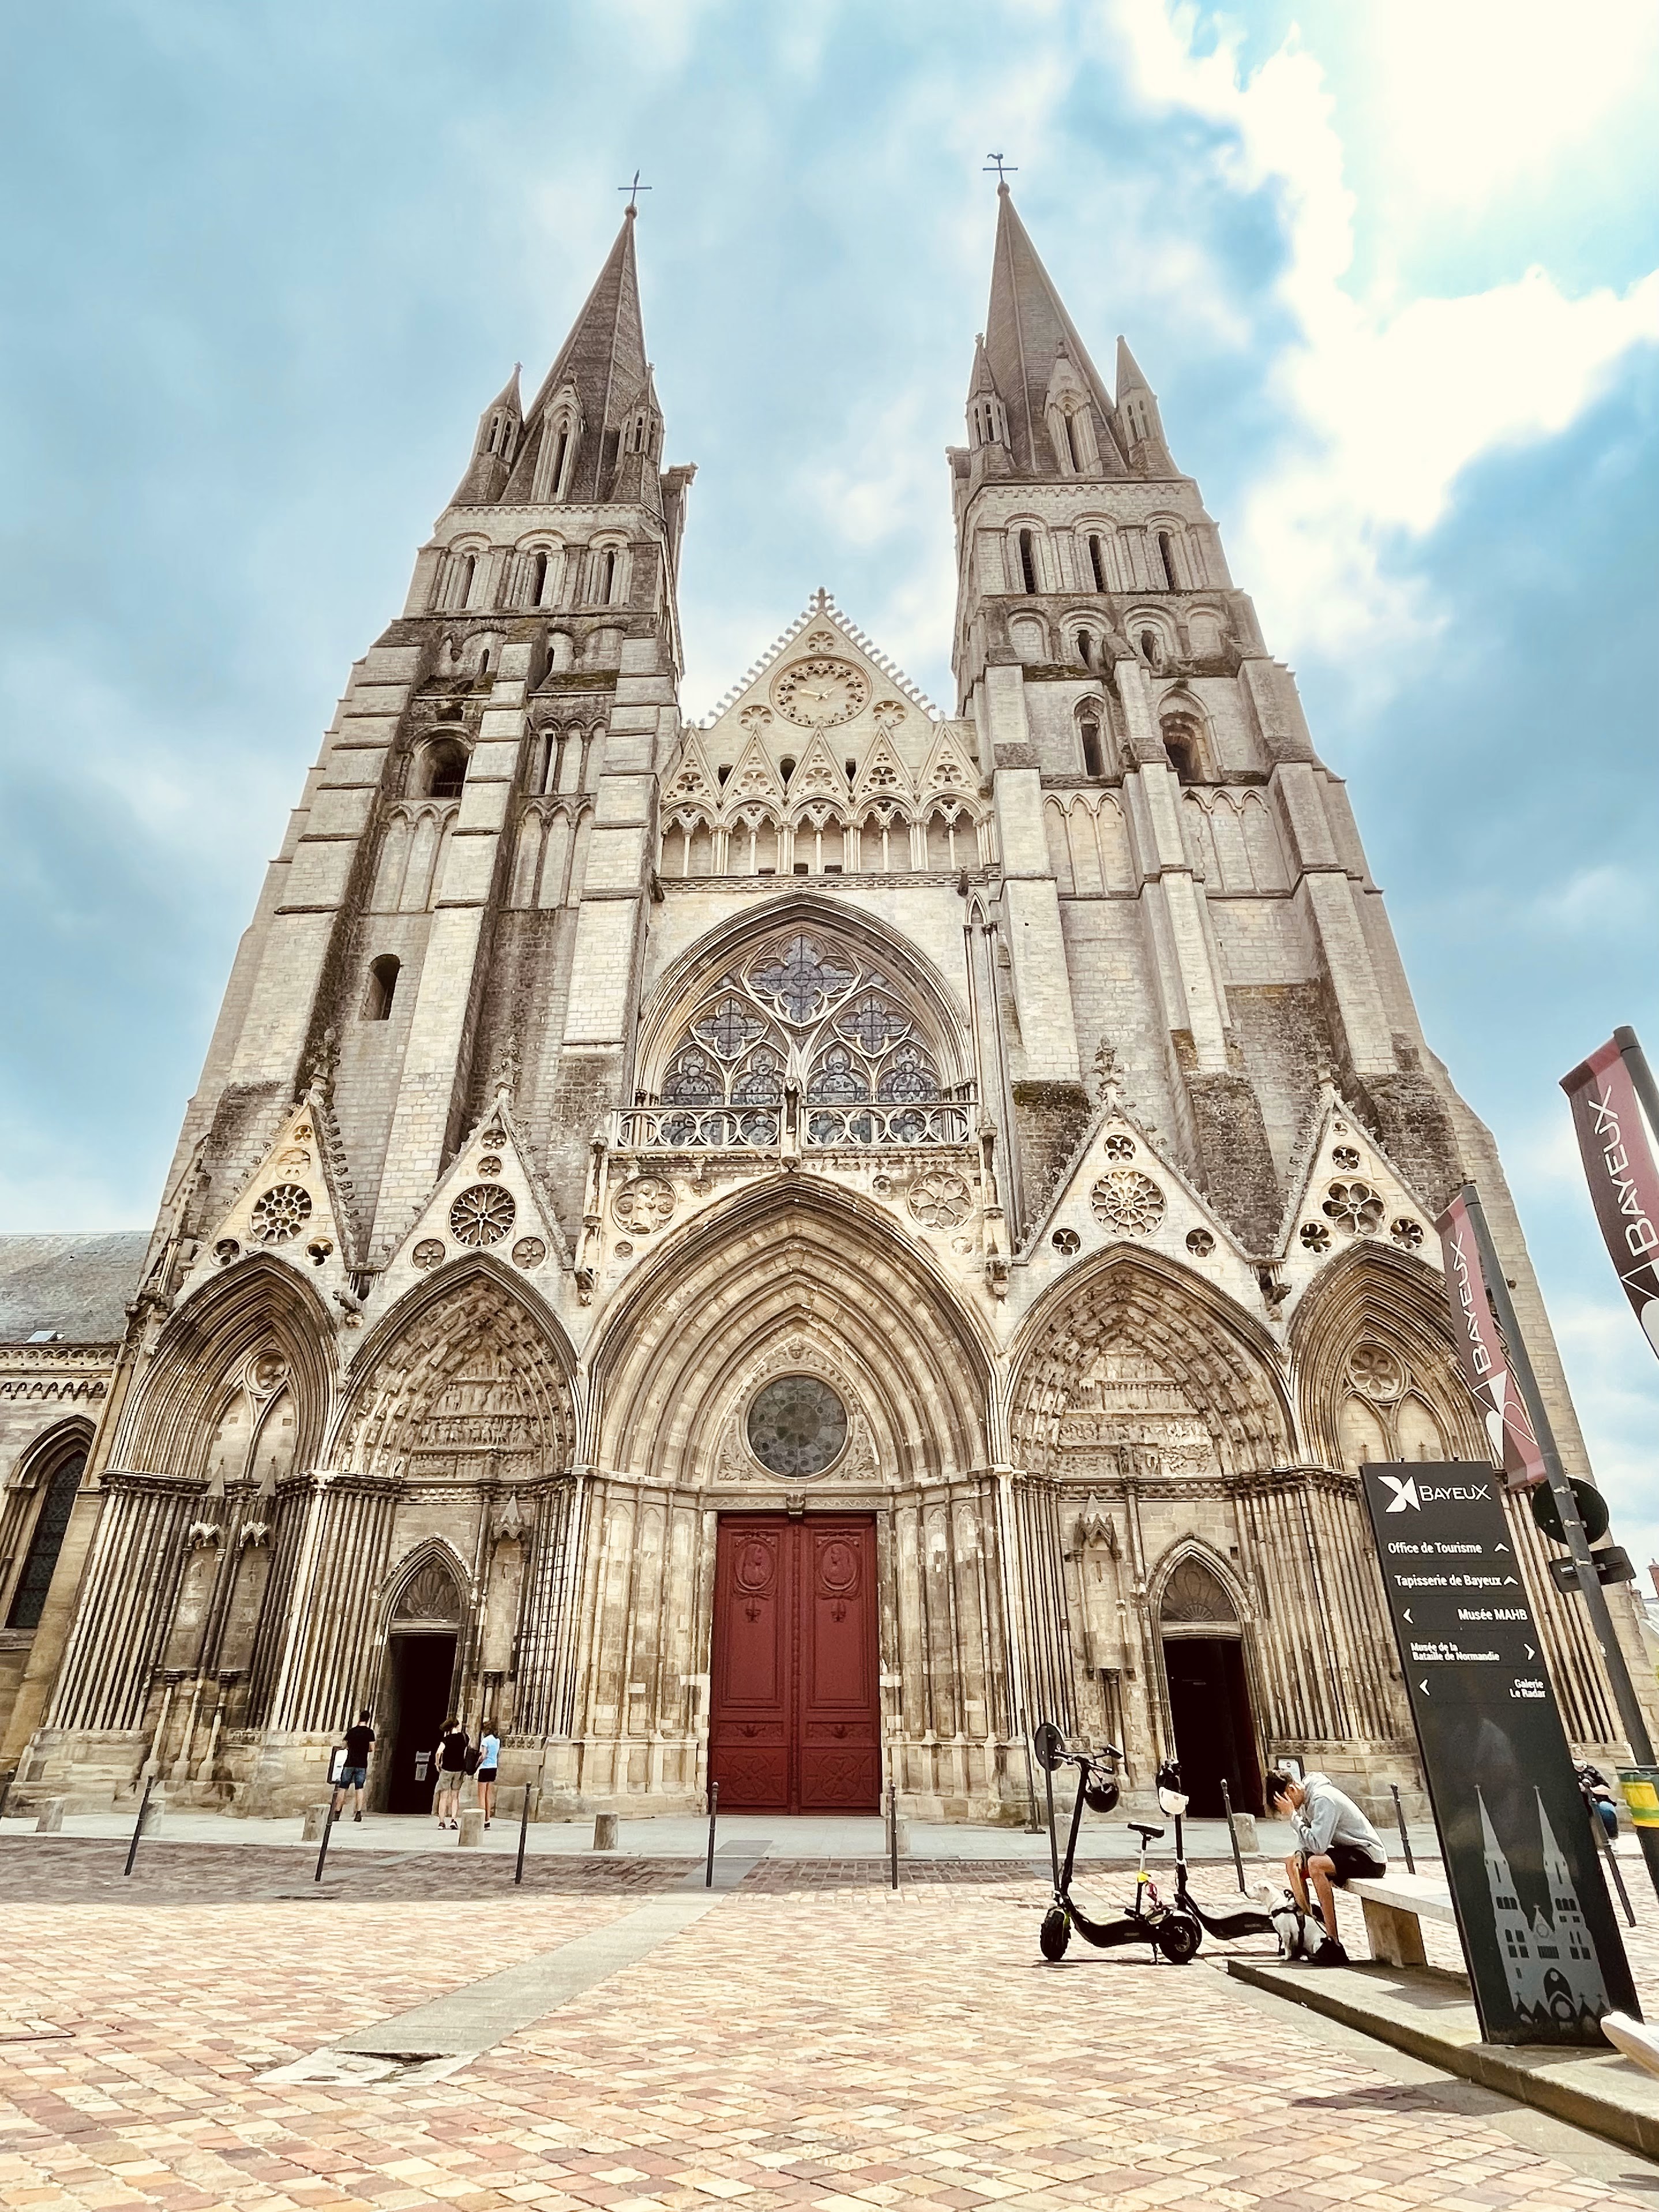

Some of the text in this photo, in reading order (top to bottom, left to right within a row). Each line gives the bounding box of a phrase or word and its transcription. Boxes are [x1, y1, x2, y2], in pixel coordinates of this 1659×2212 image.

[1587, 1085, 1659, 1257] BAYEUX
[1450, 1231, 1493, 1375] BAYEUX
[1418, 1484, 1492, 1501] BAYEUX
[1388, 1542, 1482, 1554] Office de Tourisme
[1394, 1574, 1502, 1589] Tapisserie de Bayeux
[1458, 1608, 1529, 1620] Musée MAHB
[1410, 1642, 1458, 1652] Musée de la
[1413, 1651, 1500, 1661] Bataille de Normandie
[1514, 1678, 1544, 1689] Galerie
[1509, 1688, 1546, 1698] Le Radar
